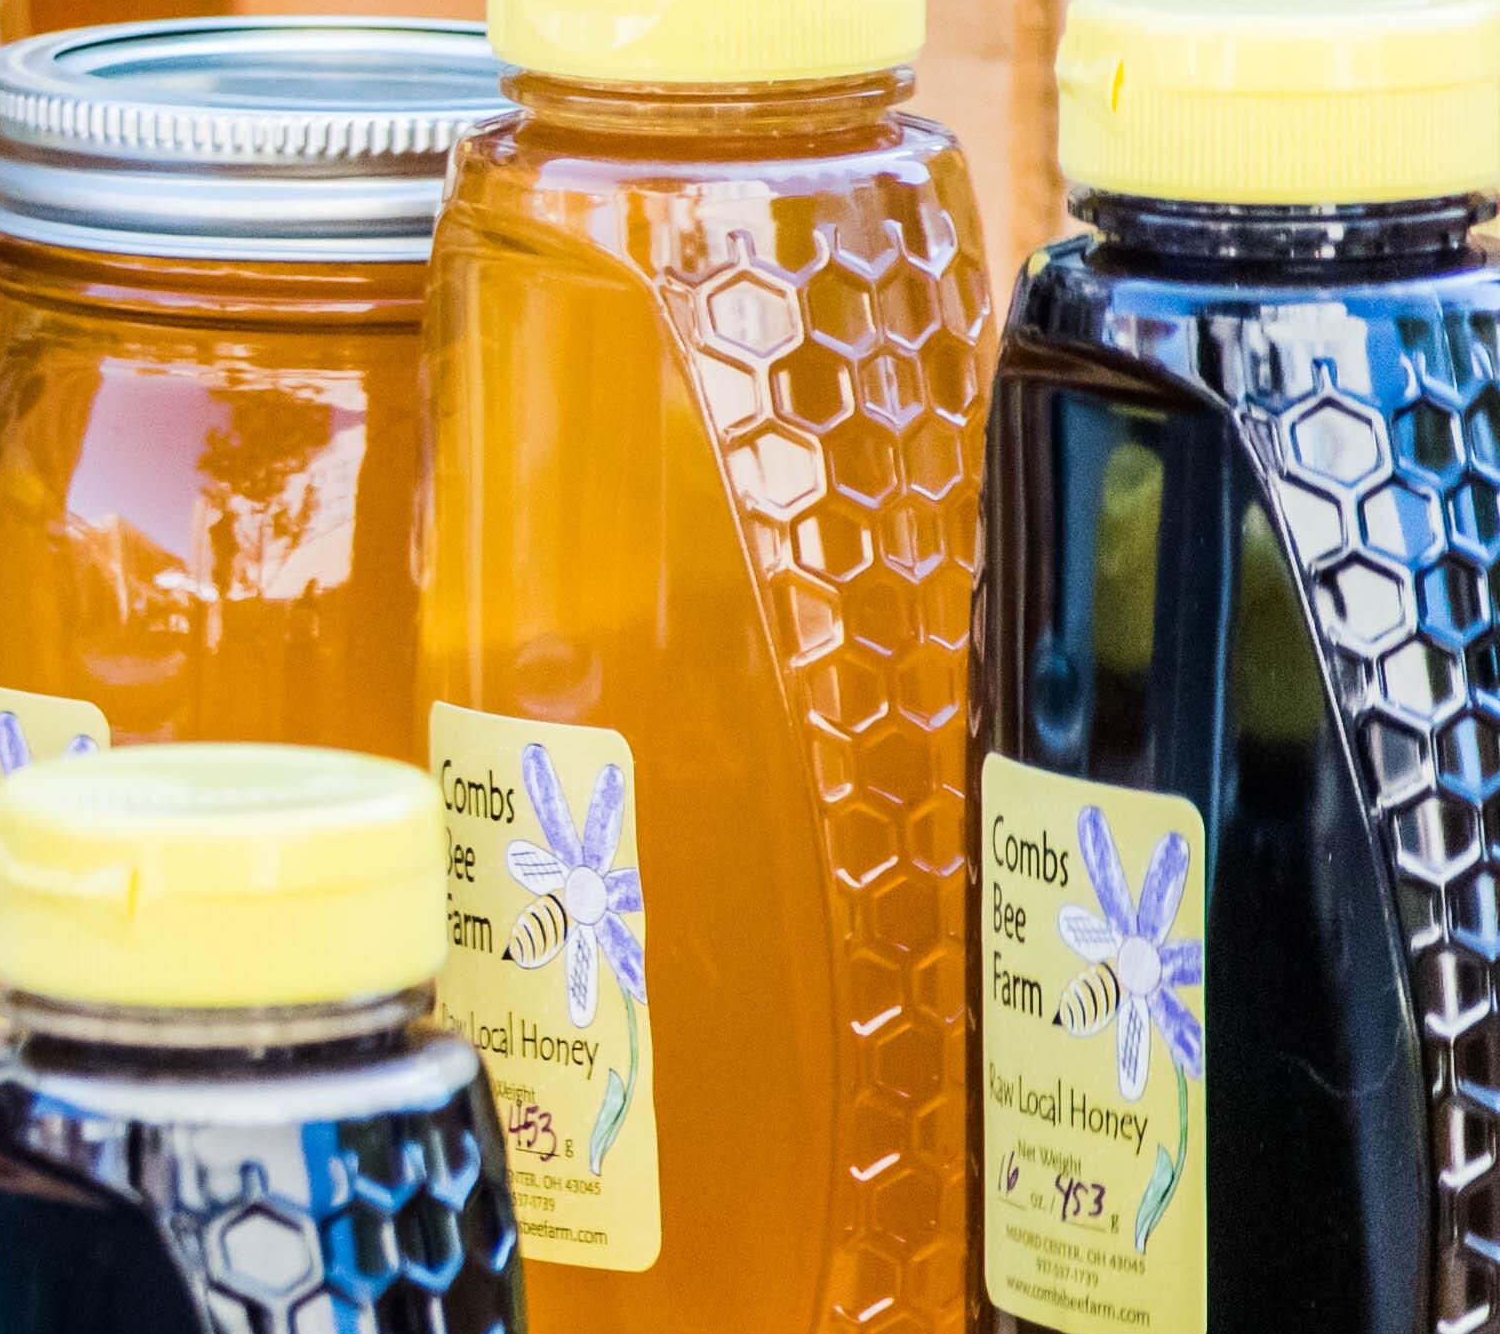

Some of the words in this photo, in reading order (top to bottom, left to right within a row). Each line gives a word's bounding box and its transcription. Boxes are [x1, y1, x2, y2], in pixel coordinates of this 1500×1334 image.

[441, 759, 514, 823] Combs
[993, 815, 1068, 887] Combs
[993, 881, 1026, 943] Bee
[993, 950, 1042, 1018] Farm
[470, 1011, 513, 1059] Local
[522, 1020, 599, 1080] Honey
[508, 1099, 558, 1162] 453
[989, 1062, 1014, 1107] Raw
[1019, 1075, 1062, 1127] Local
[1070, 1088, 1148, 1157] Honey
[543, 1175, 562, 1190] OH
[566, 1179, 601, 1195] 43045
[998, 1150, 1019, 1195] 16
[1054, 1173, 1106, 1222] 453
[1018, 1140, 1037, 1162] Net
[1040, 1149, 1081, 1179] Weight
[519, 1220, 608, 1245] sbeefarm.com
